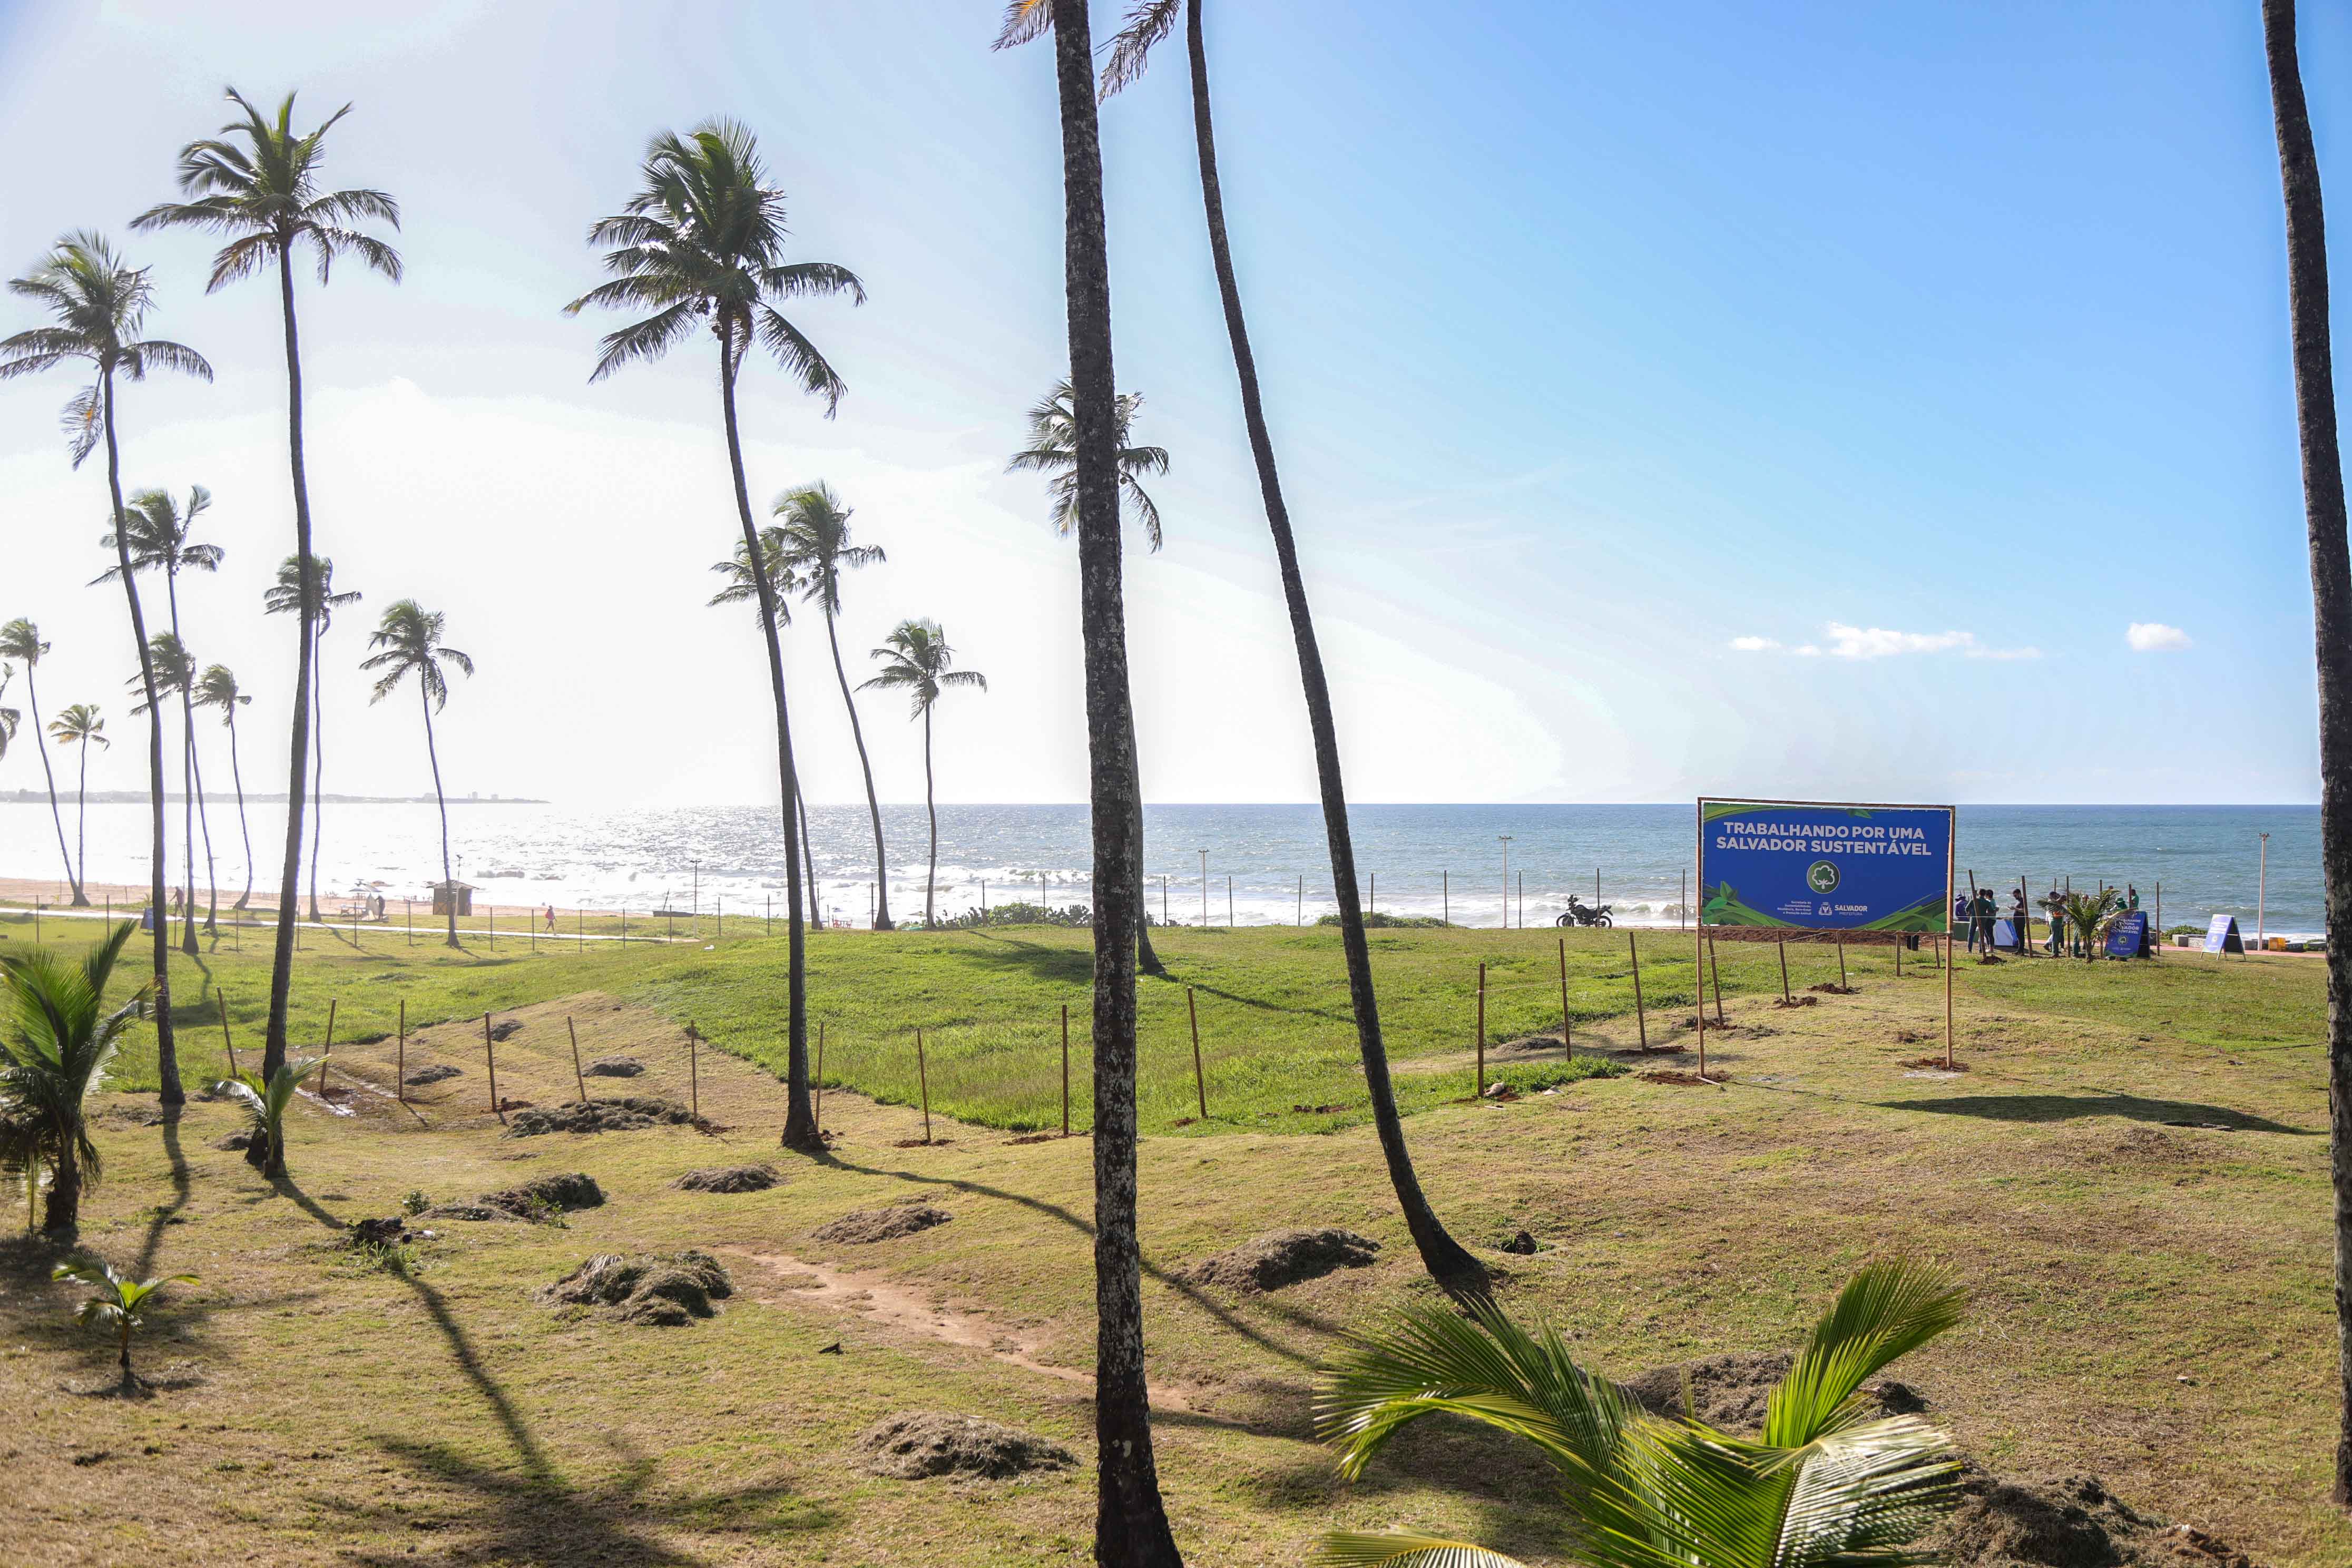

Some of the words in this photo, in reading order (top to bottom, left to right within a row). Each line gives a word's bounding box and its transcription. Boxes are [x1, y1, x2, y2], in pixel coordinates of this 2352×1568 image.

[1723, 821, 1849, 838] TRABALHANDO
[1853, 828, 1885, 839] POR
[1889, 828, 1925, 839] UMA
[1716, 837, 1806, 852] SALVADOR
[1811, 839, 1932, 856] SUSTENTÁVEL
